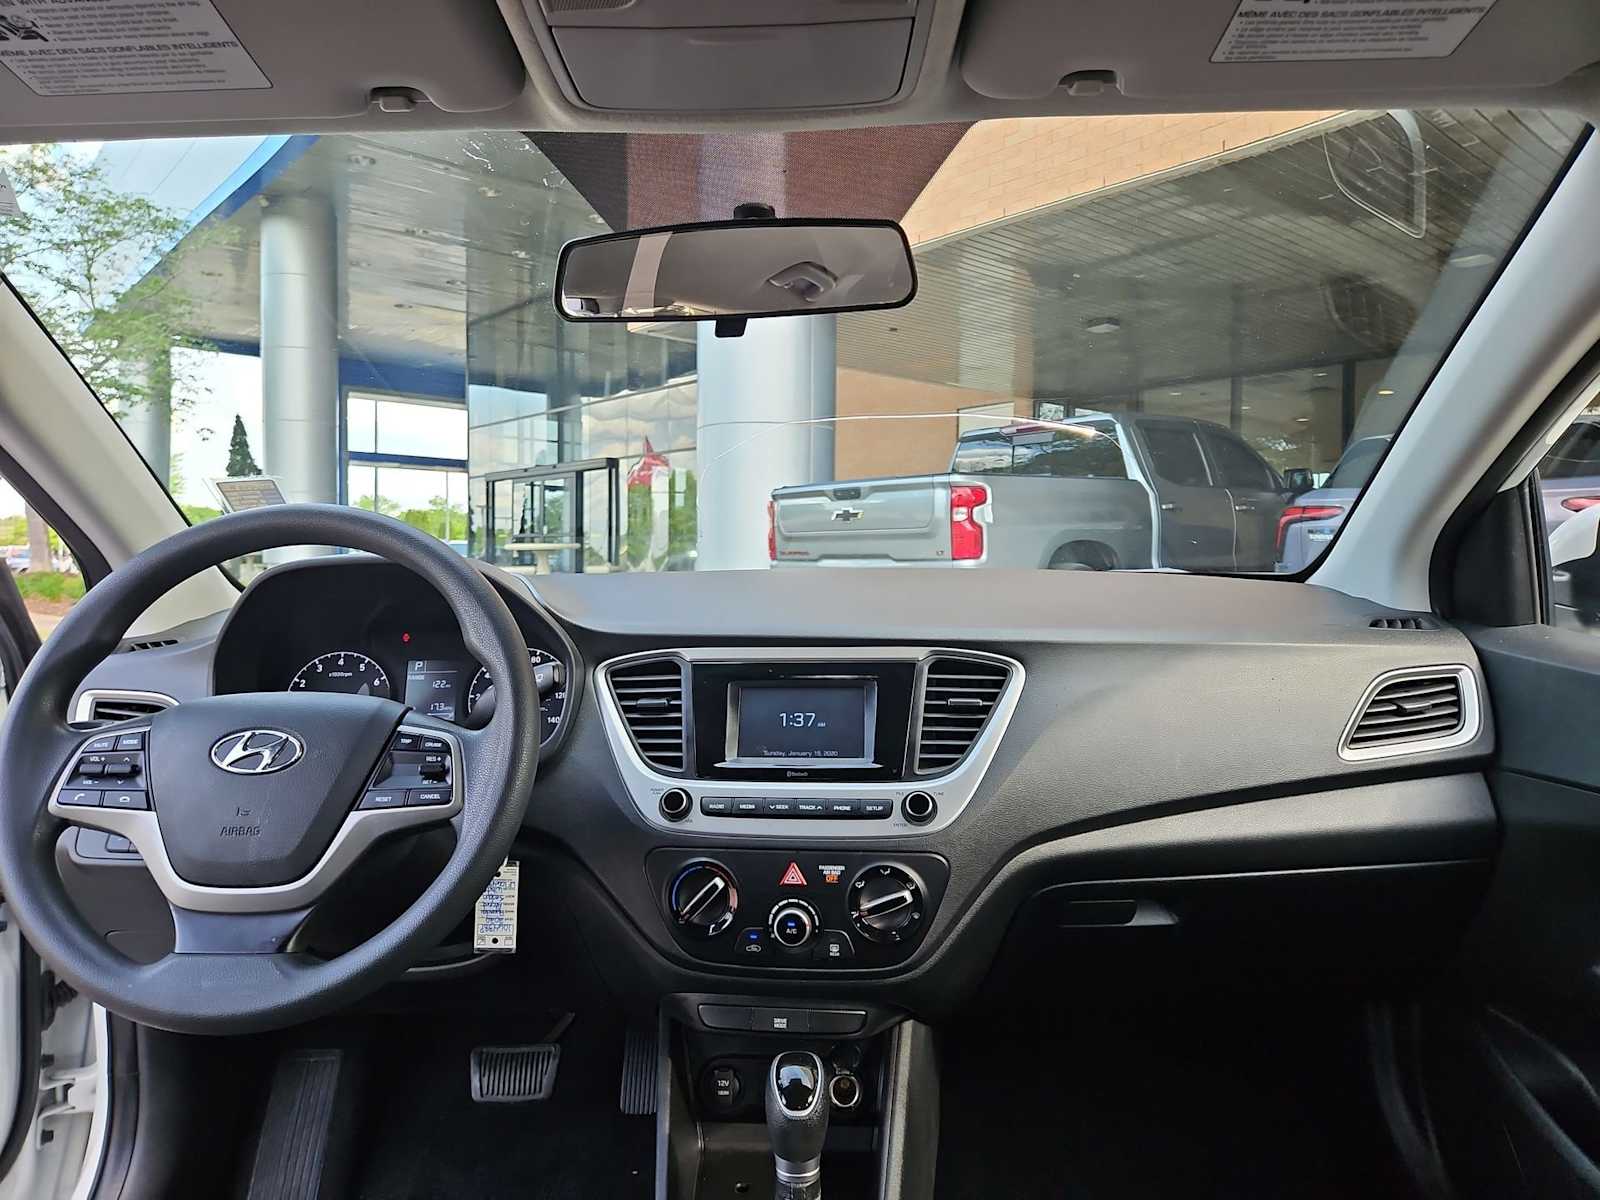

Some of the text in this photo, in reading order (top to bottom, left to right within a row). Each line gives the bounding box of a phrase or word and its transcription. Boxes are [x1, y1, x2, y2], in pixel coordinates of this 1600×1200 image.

[1298, 10, 1319, 18] DES
[338, 658, 344, 666] 4
[531, 656, 541, 664] 80
[316, 664, 322, 673] 3
[360, 664, 366, 672] 5
[414, 661, 423, 671] P
[300, 680, 306, 688] 2
[432, 680, 446, 688] 122
[547, 716, 560, 724] 140
[779, 712, 816, 728] 1:37
[788, 750, 813, 758] January
[219, 826, 261, 837] AIRBAG
[825, 875, 839, 883] OFF
[717, 1079, 730, 1087] 12V
